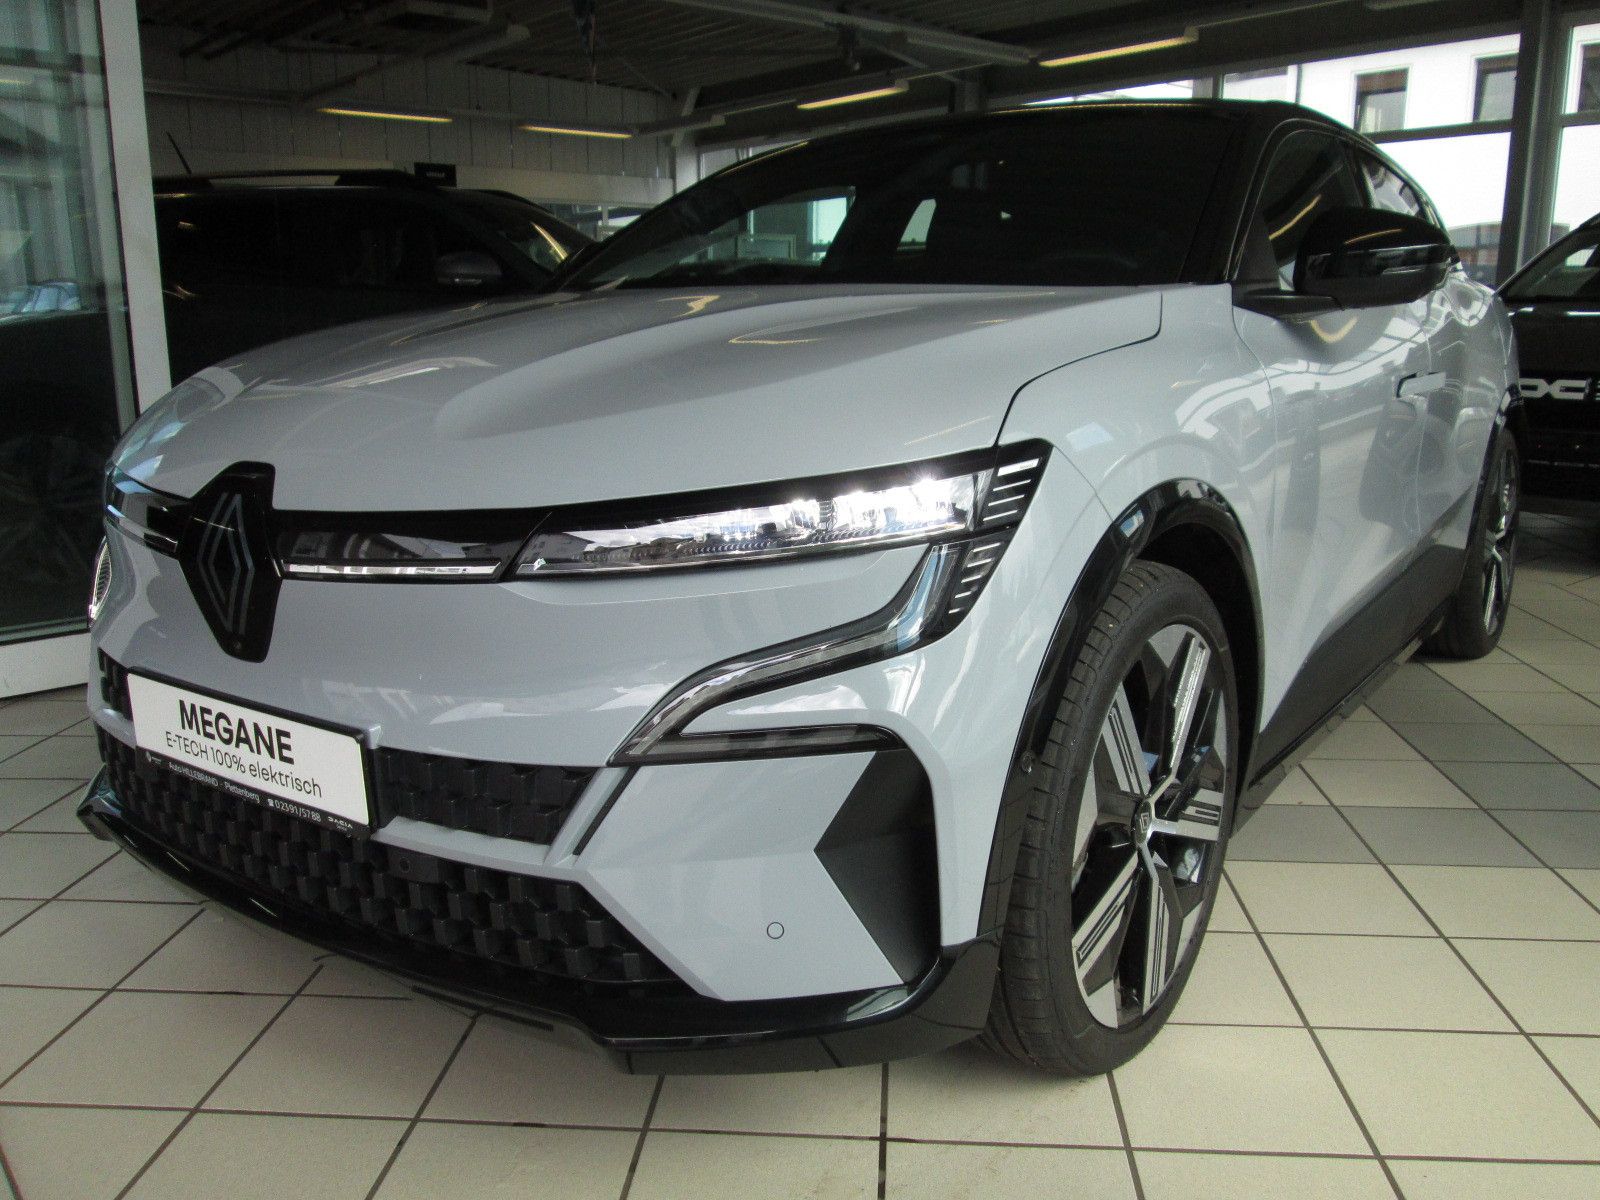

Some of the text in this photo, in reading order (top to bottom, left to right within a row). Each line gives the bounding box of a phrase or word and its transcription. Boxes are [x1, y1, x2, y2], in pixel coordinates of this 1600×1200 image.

[166, 731, 322, 798] E-TECH 100% elektrisch
[179, 699, 295, 765] MEGANE
